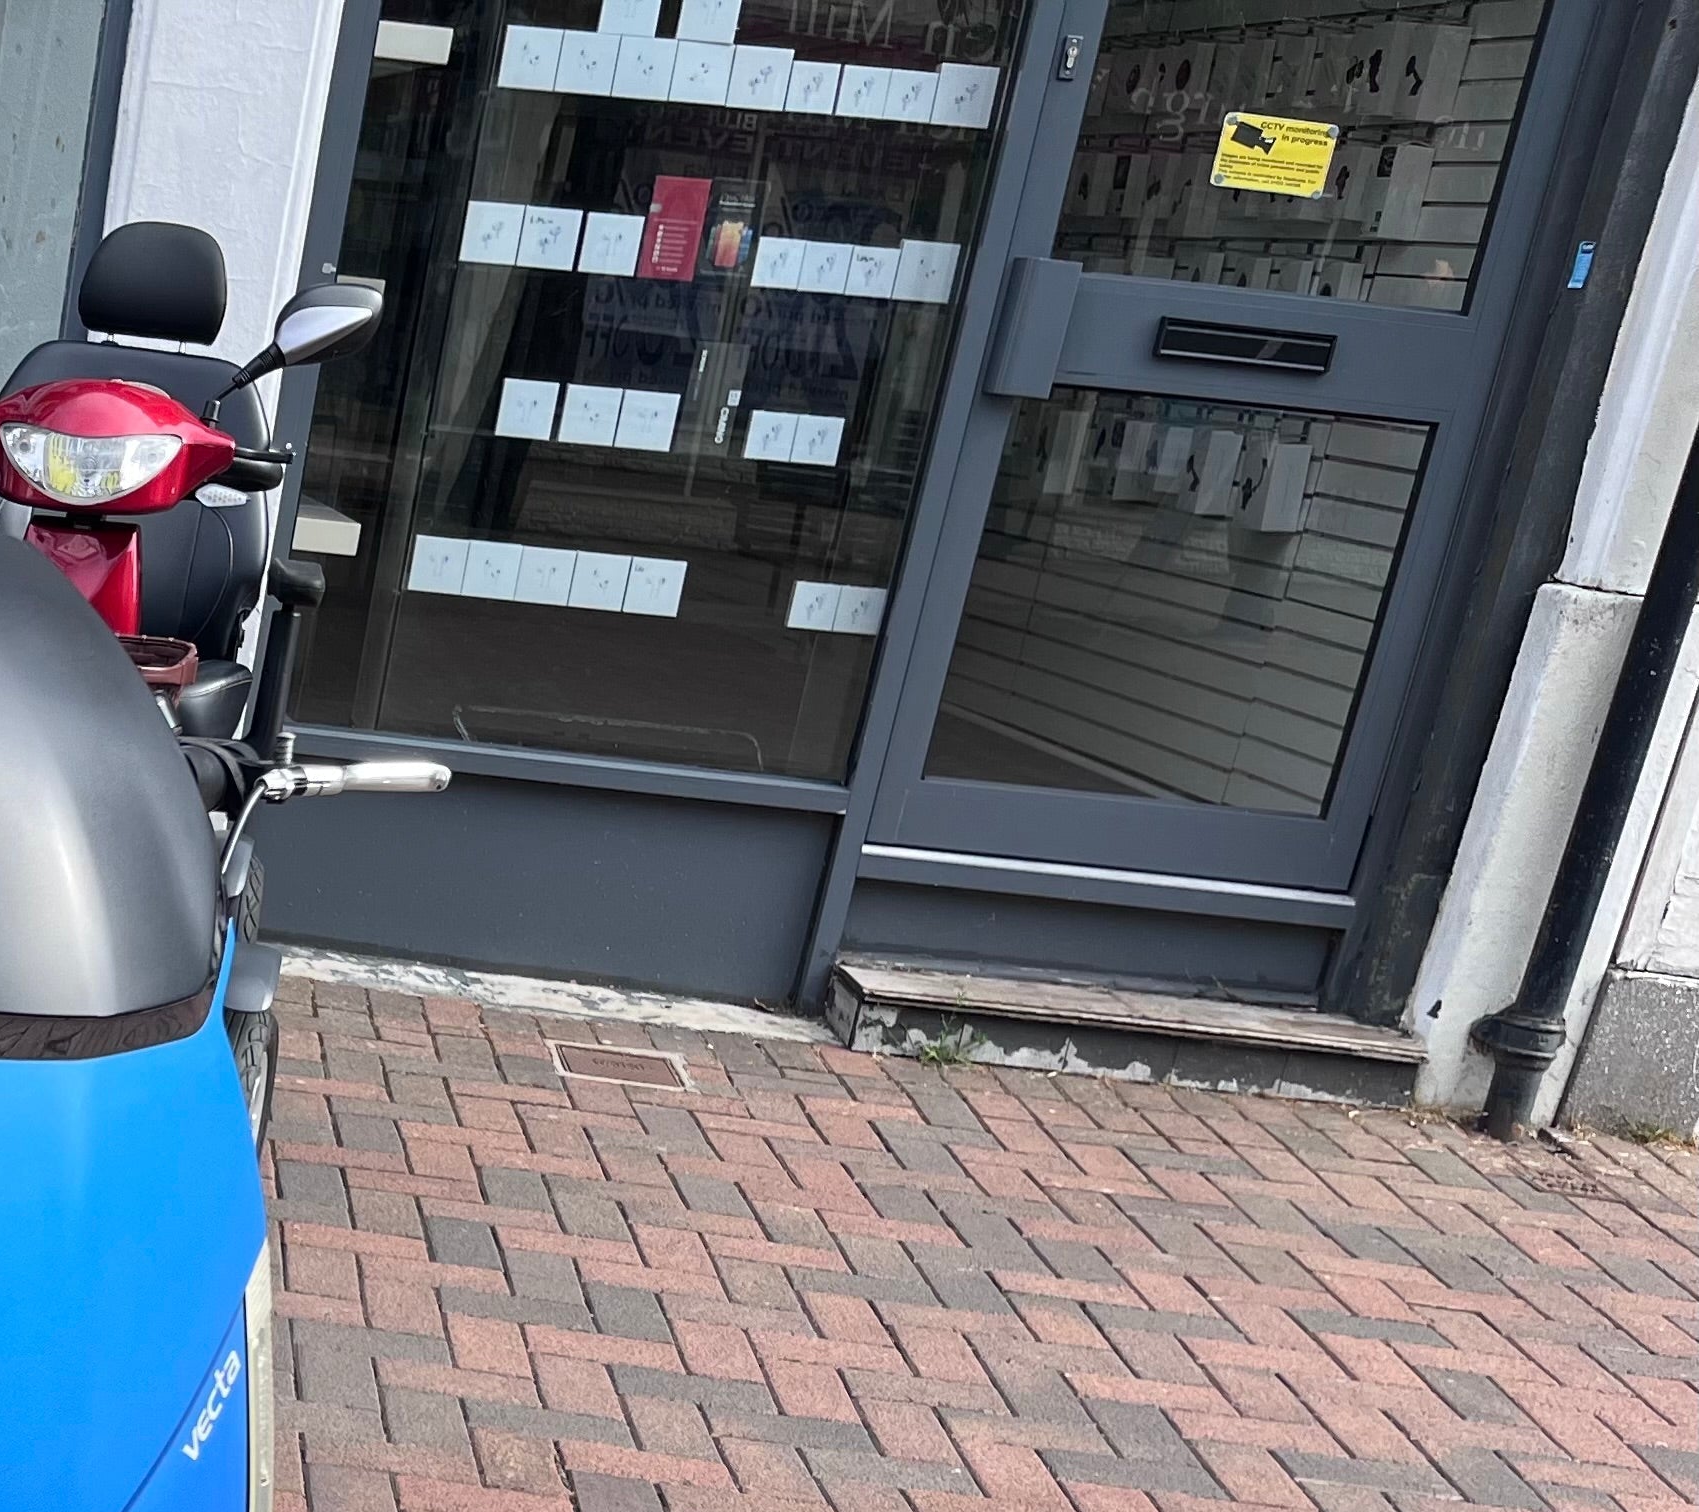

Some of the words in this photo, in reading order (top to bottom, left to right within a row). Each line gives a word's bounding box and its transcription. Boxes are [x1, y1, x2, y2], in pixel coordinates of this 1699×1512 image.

[1260, 121, 1285, 131] CCTV
[1281, 134, 1290, 142] in
[1290, 136, 1328, 146] progress
